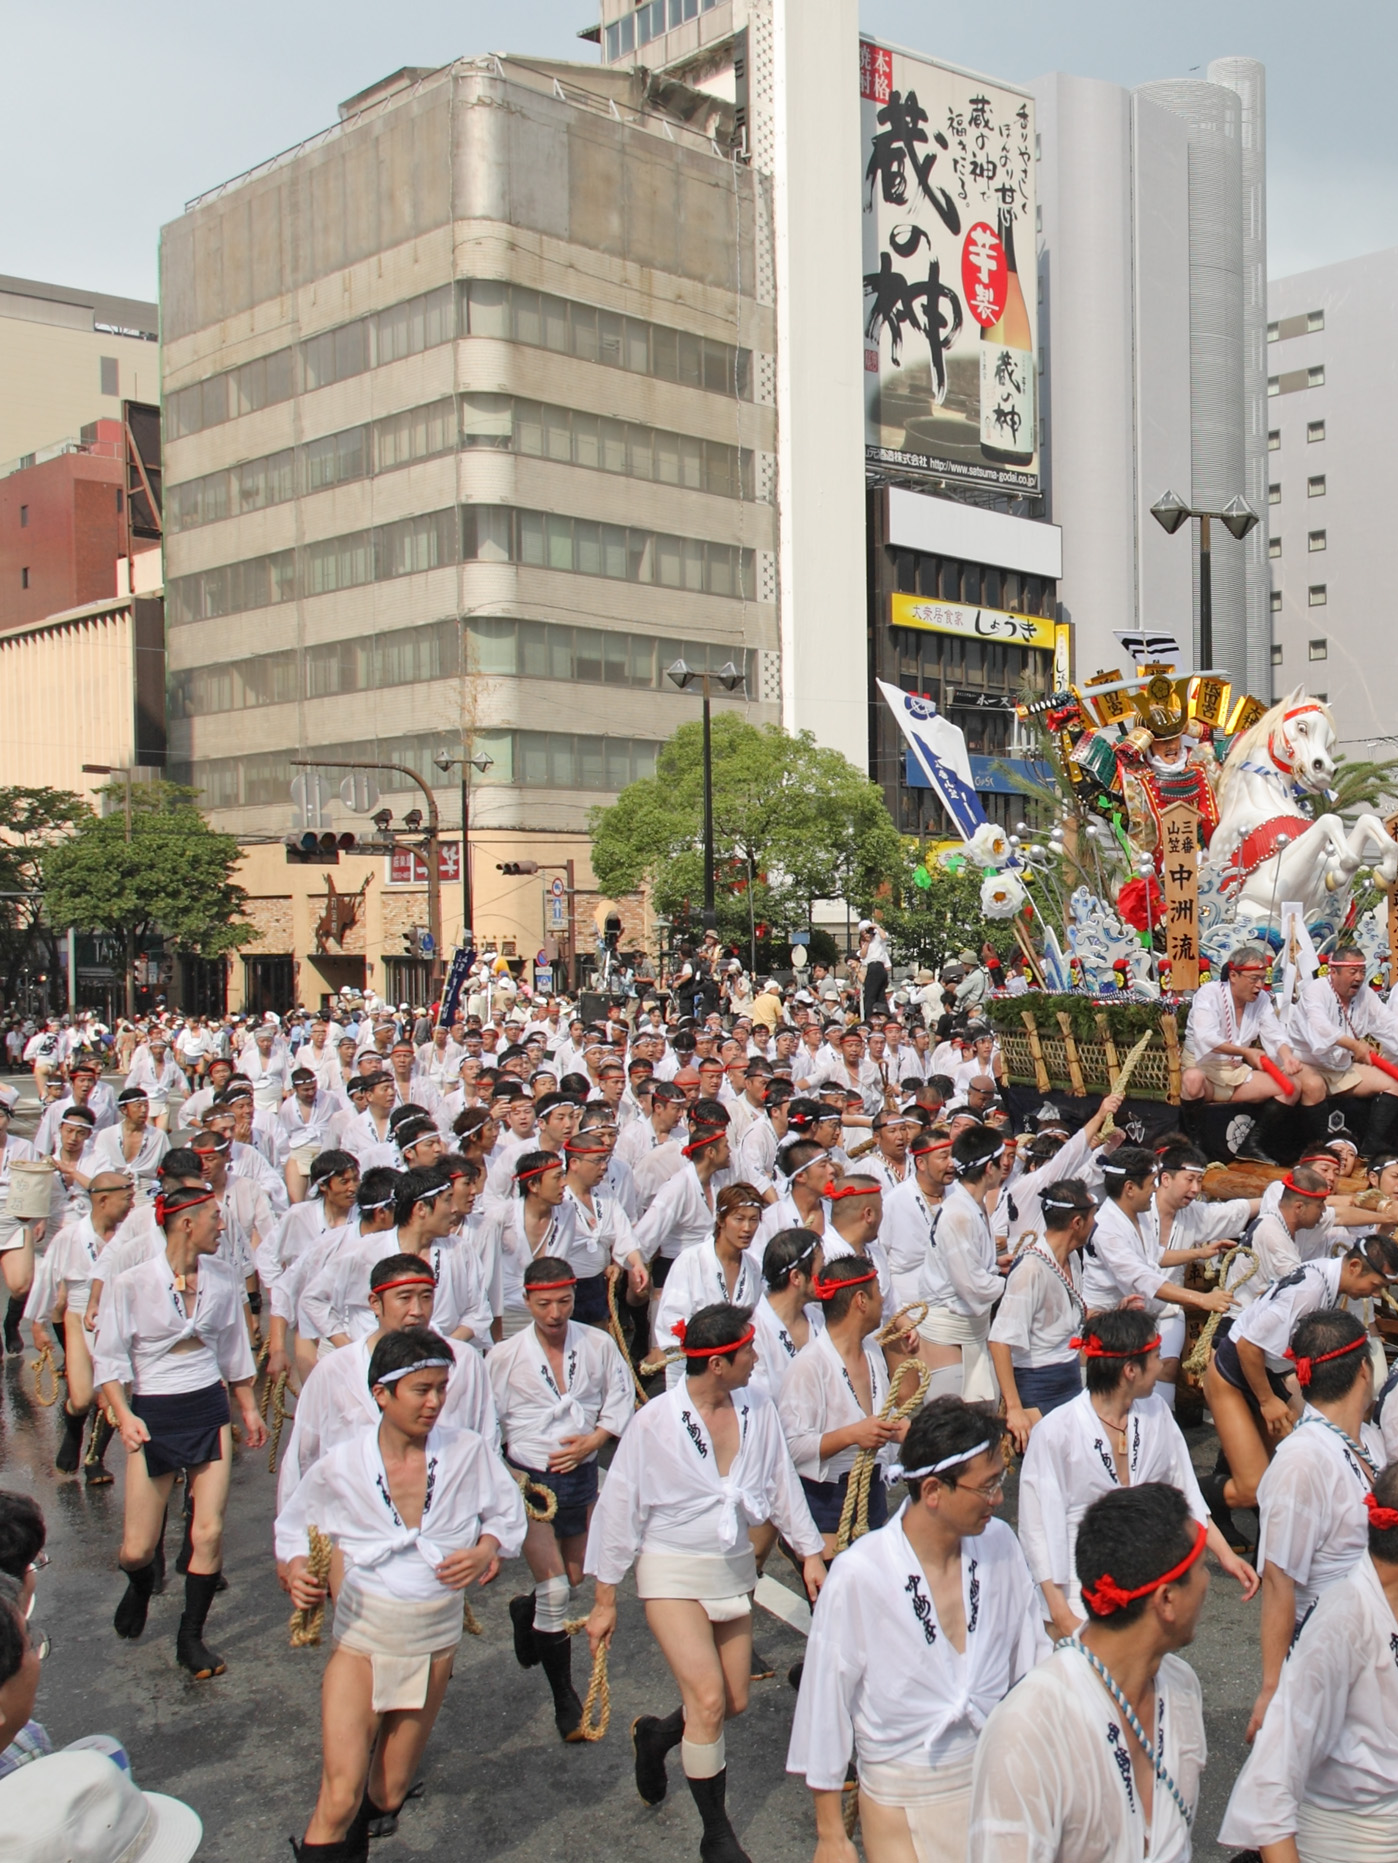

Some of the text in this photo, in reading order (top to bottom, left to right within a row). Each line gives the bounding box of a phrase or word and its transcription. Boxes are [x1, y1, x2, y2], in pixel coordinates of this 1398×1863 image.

[874, 50, 890, 101] 本格
[862, 89, 964, 406] 蔵の神
[929, 456, 1038, 487] http://www.satsuma-godai.co.jp/
[974, 609, 1038, 644] しょうき
[1167, 820, 1181, 854] 山笠
[1181, 820, 1195, 854] 三番
[1168, 863, 1196, 961] 中洲流
